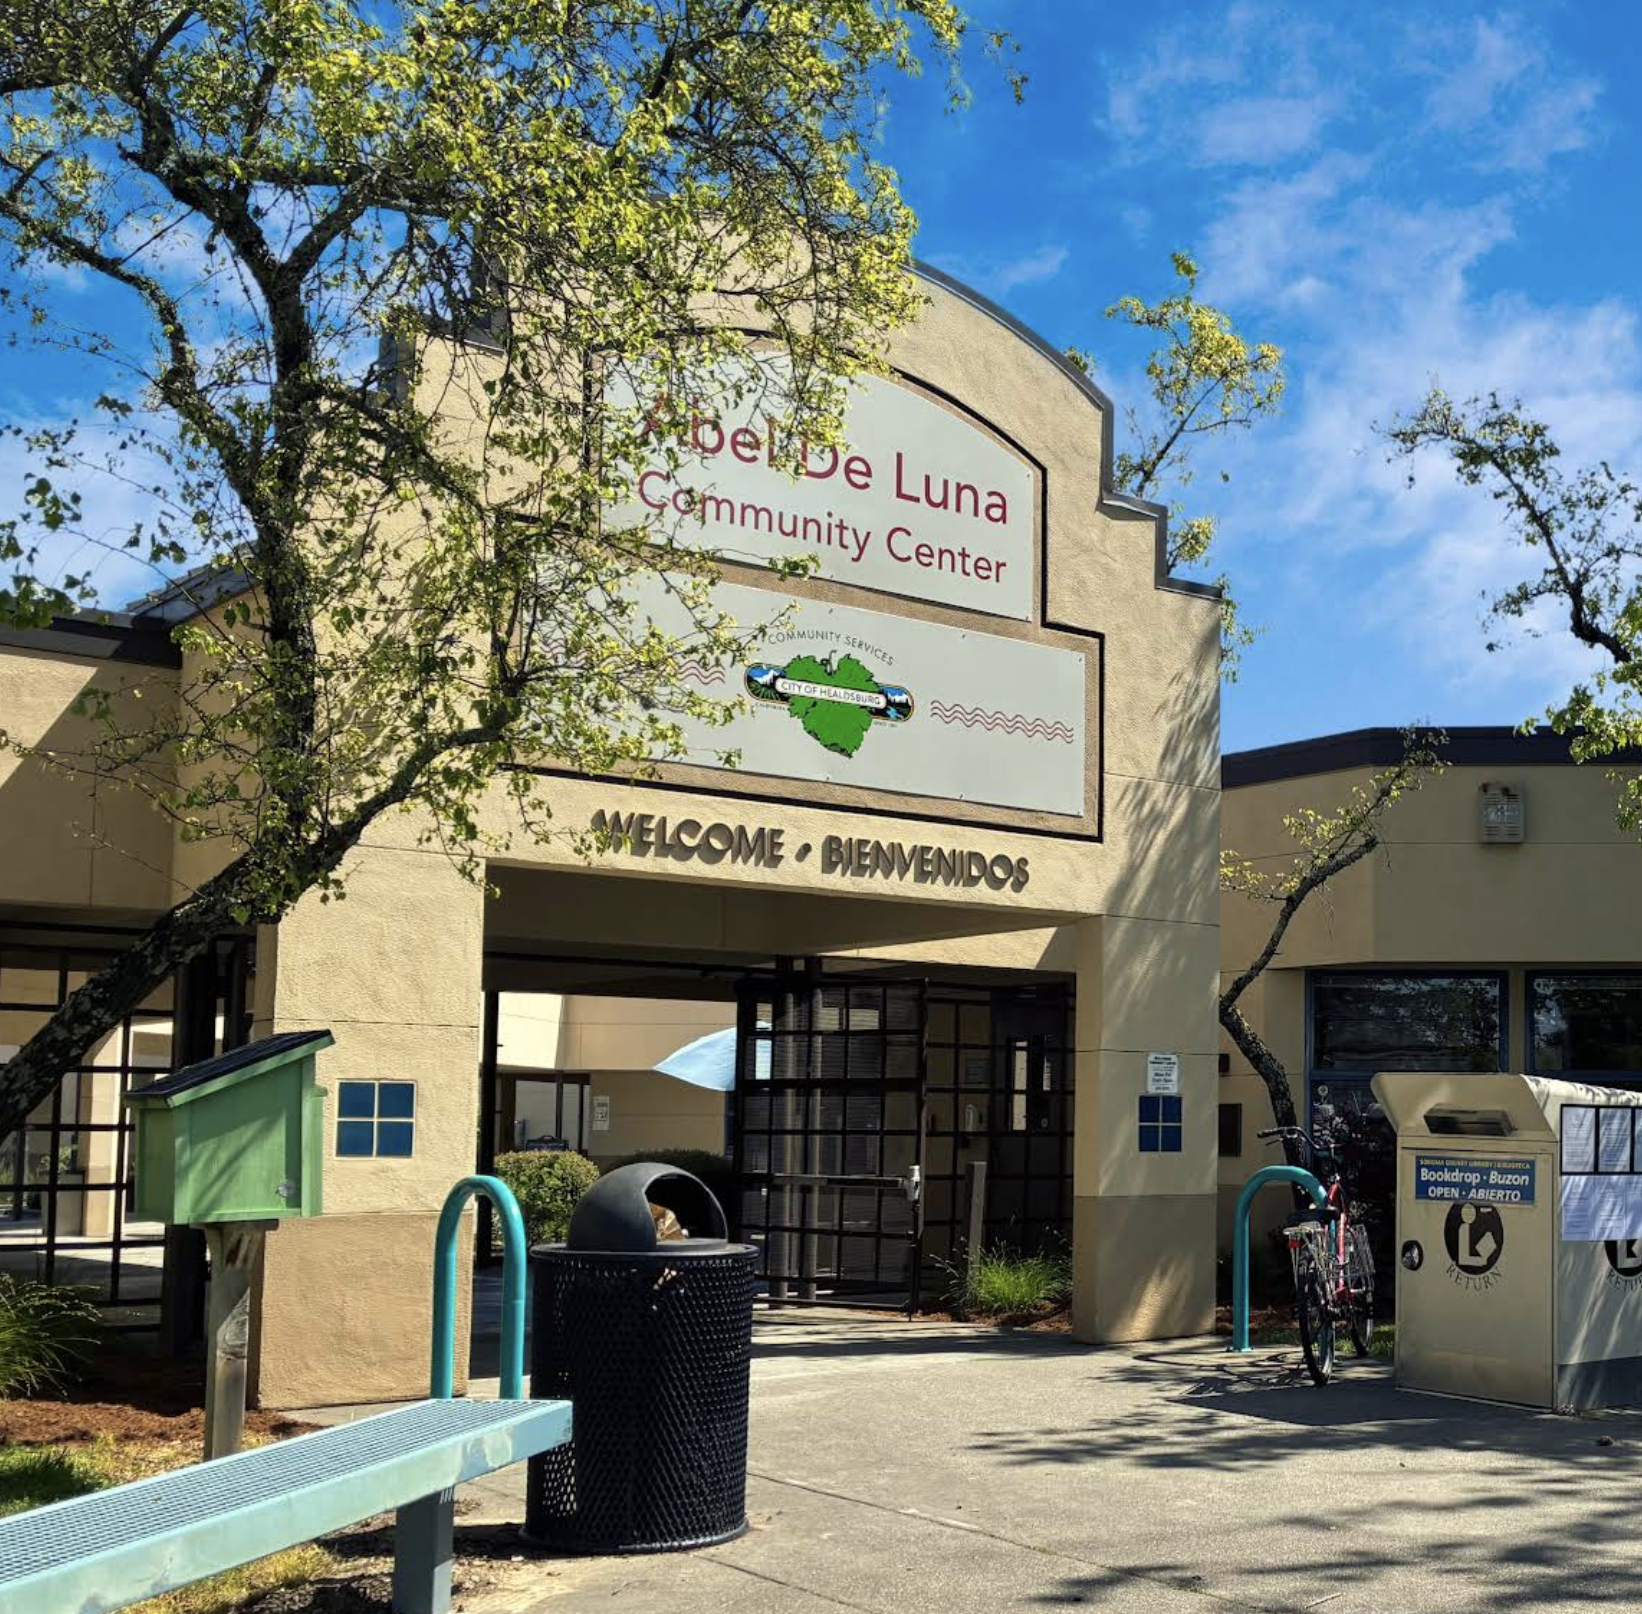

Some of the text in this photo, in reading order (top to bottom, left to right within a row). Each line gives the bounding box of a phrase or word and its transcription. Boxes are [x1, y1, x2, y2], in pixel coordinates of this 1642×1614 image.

[801, 425, 873, 490] De
[896, 452, 1007, 524] Luna
[638, 471, 1006, 583] Community Center
[768, 630, 896, 666] COMMUNITY SERVICES
[781, 681, 881, 705] CITY OF HEALDSBURG
[590, 809, 1030, 893] WELCOME BIENVENIDOS
[1420, 1167, 1530, 1186] Bookdrop Buzon
[1428, 1186, 1521, 1201] OPEN ABIERTO
[1446, 1263, 1502, 1292] RETURN
